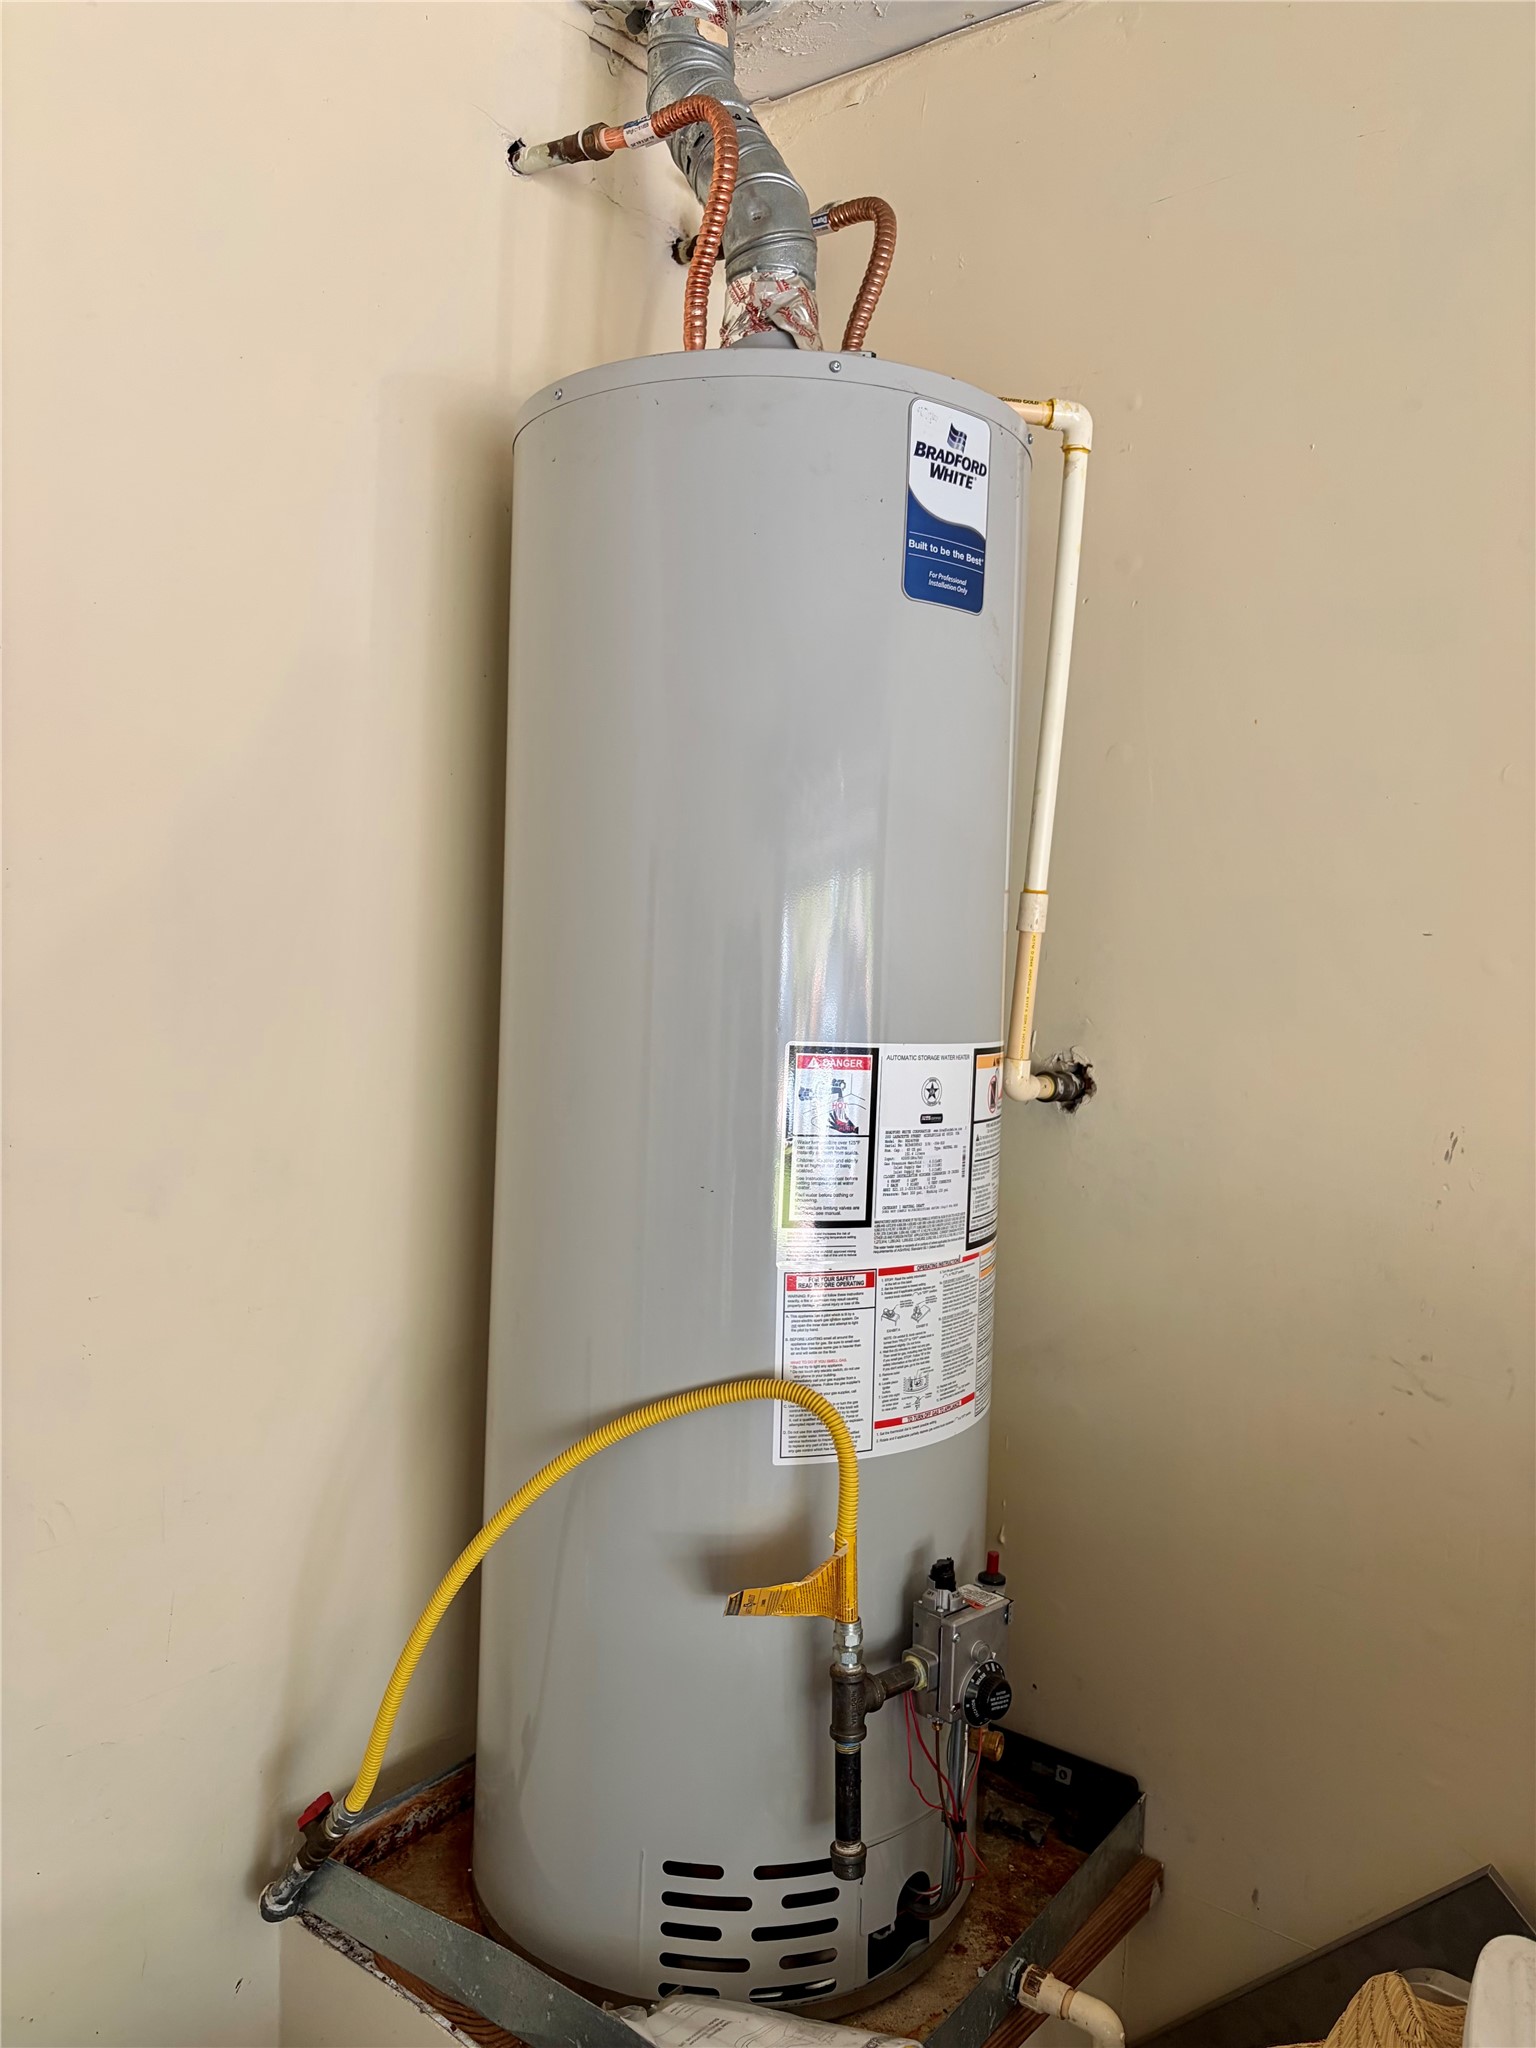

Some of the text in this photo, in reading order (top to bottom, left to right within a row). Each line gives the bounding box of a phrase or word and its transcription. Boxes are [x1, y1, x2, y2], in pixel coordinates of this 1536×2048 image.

[914, 441, 987, 477] BRADFORD
[909, 539, 928, 552] Built
[930, 542, 938, 554] to
[940, 546, 950, 557] be
[952, 548, 964, 561] the
[928, 579, 968, 595] Installation Only
[937, 572, 967, 586] Professional
